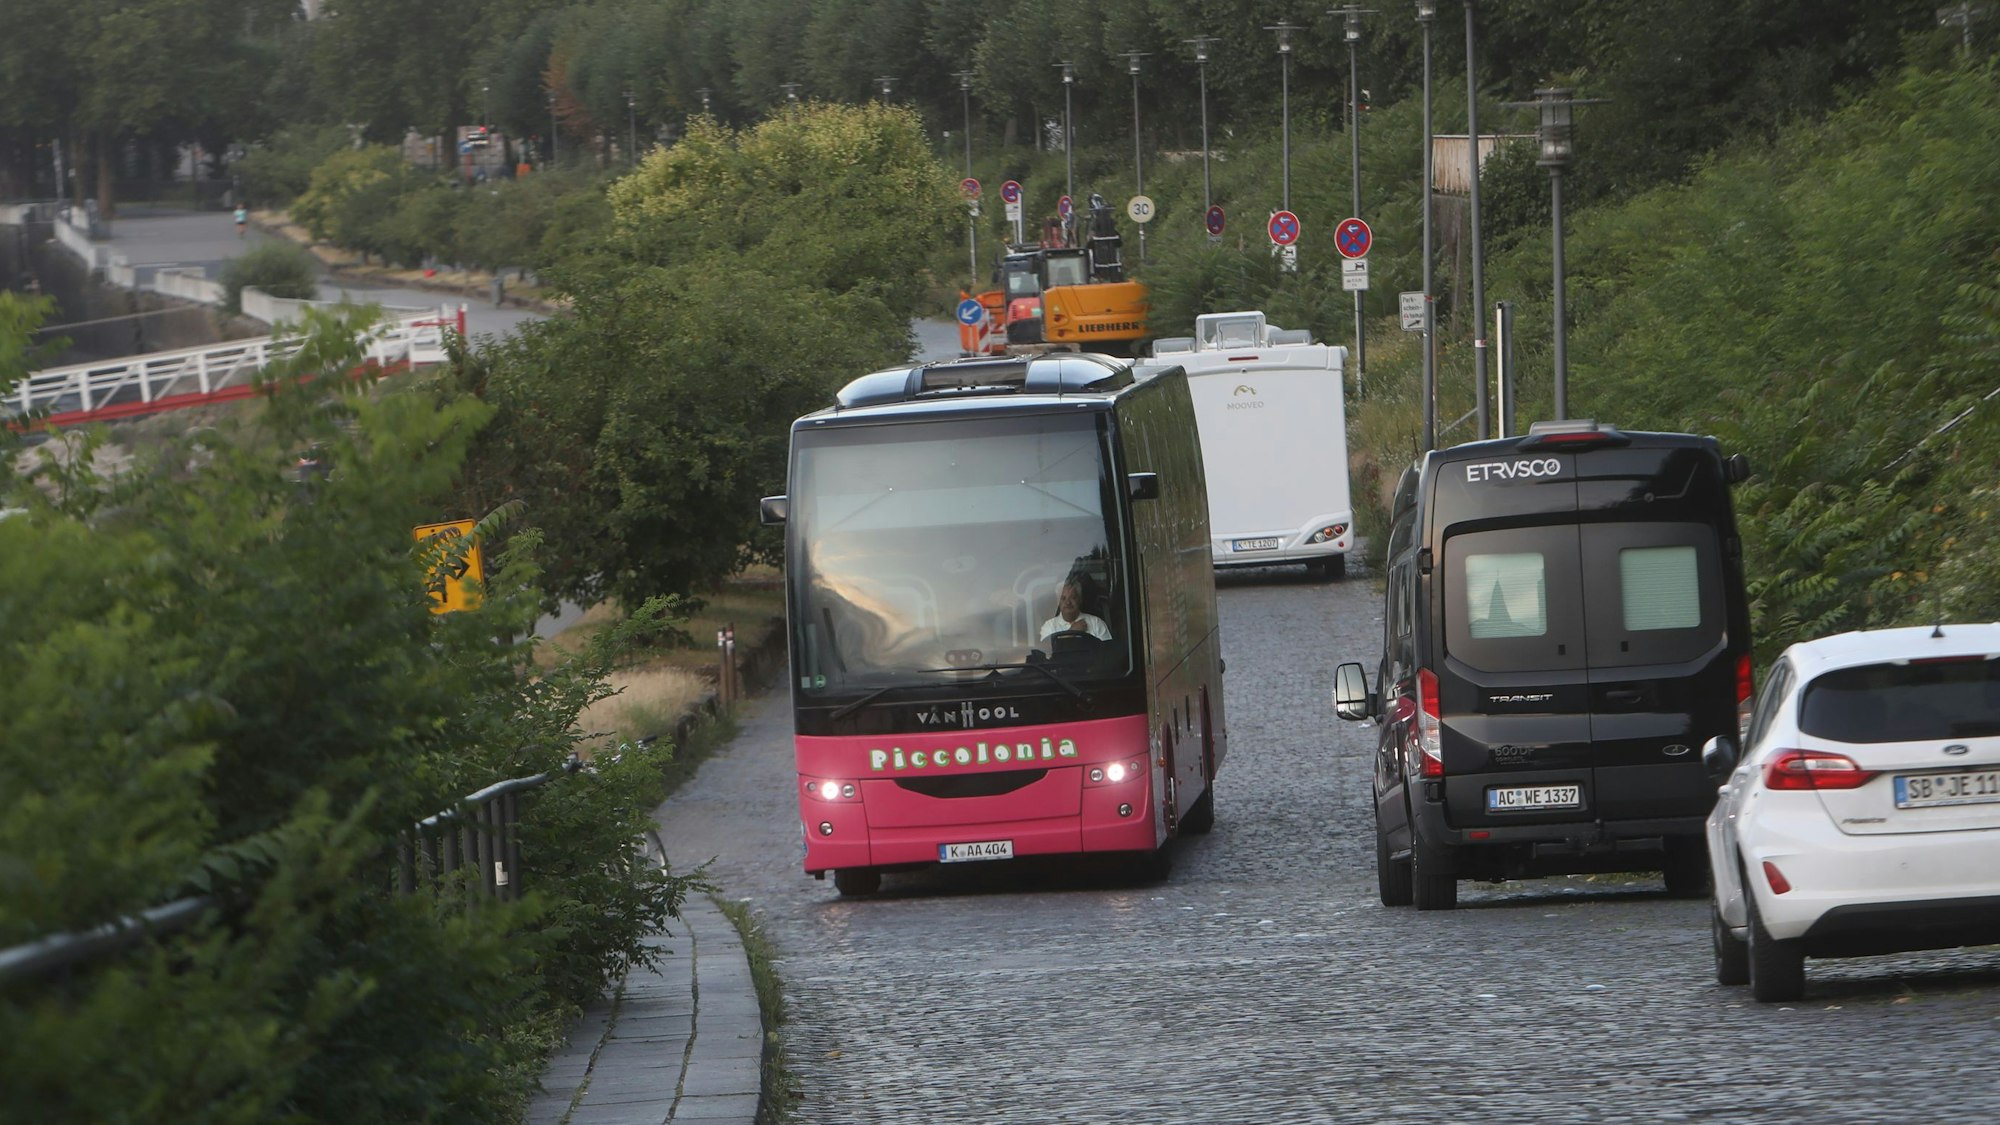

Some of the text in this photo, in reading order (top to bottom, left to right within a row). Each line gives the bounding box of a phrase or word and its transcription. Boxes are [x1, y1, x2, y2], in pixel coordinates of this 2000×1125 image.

[1133, 203, 1149, 216] 30
[1078, 321, 1140, 333] LIEBHERR
[1227, 400, 1264, 410] MOOVEO
[1489, 693, 1553, 703] TRANSIT
[870, 736, 1078, 770] Piccolonia
[1909, 774, 2000, 799] SB JE 11
[1498, 788, 1577, 806] AC WE 1337
[951, 843, 1007, 857] K AA 404
